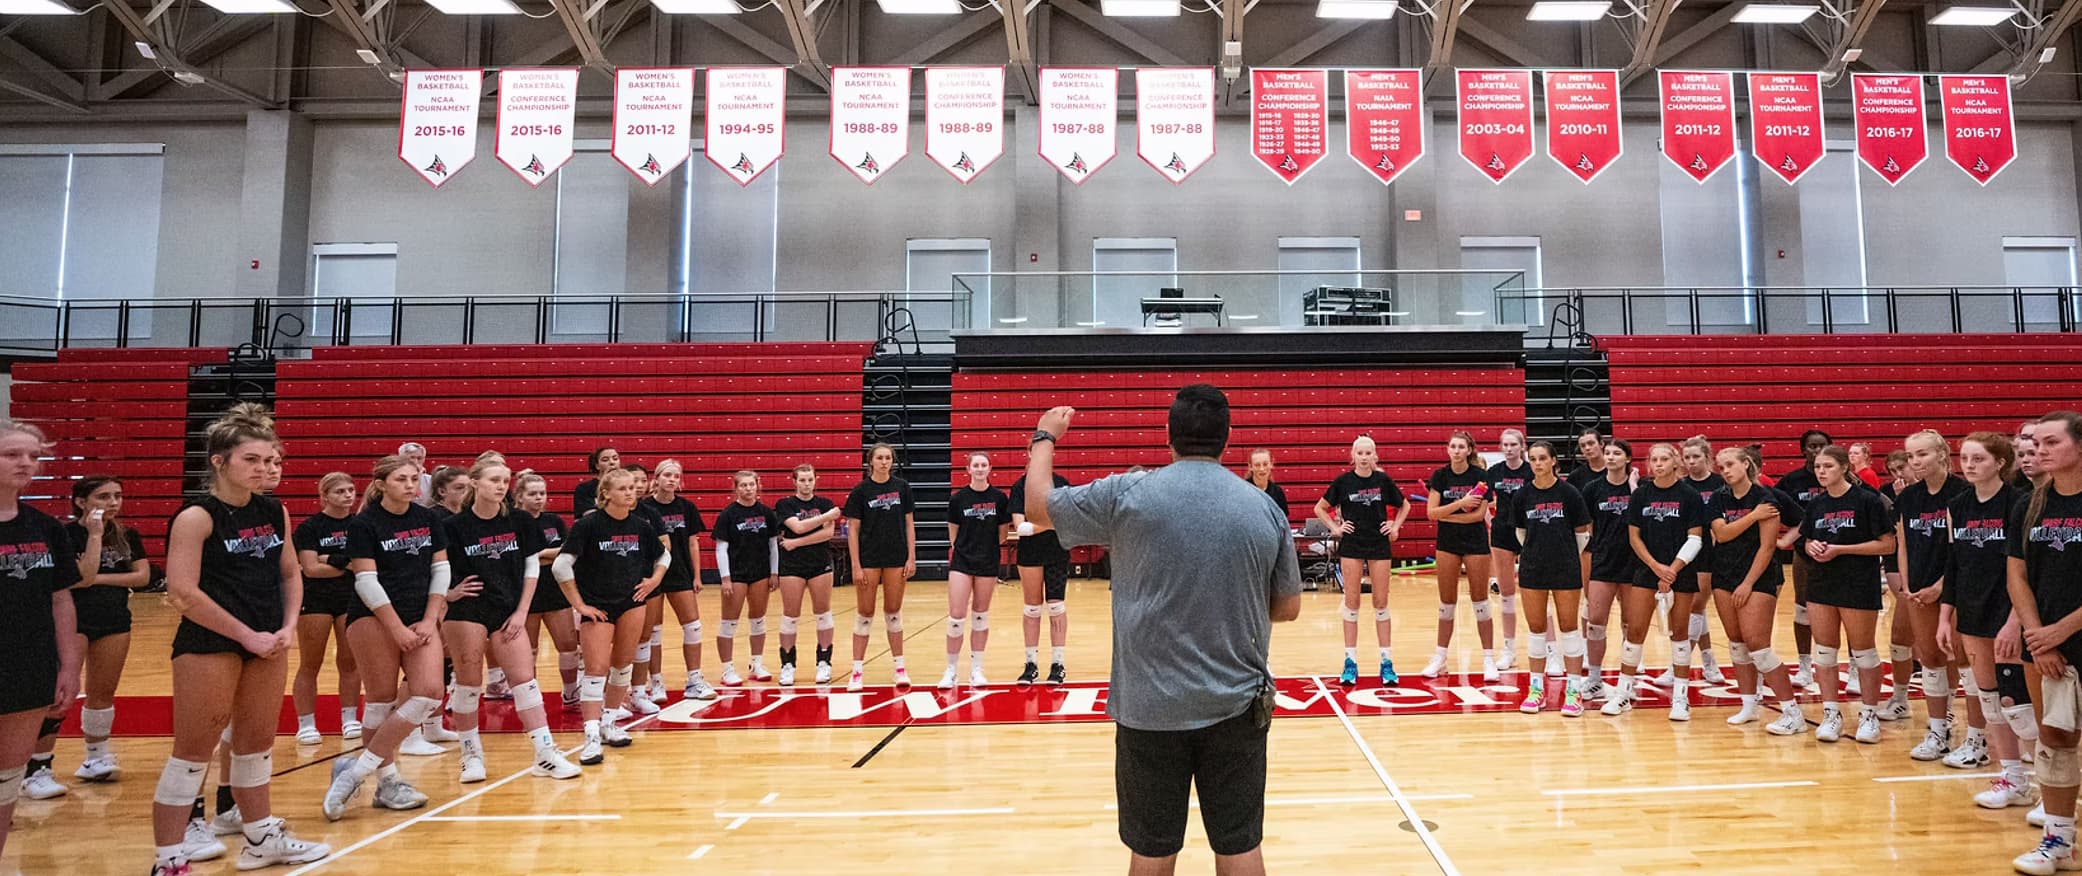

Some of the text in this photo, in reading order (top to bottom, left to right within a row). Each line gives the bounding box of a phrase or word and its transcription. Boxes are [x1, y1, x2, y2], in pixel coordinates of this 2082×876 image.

[1276, 73, 1301, 81] MEN'S
[1671, 83, 1720, 91] BASKETBALL
[1760, 84, 1809, 92] BASKETBALL
[1864, 86, 1912, 94] BASKETBALL
[1467, 94, 1521, 102] CONFERENCE
[1670, 95, 1722, 103] CONFERENCE
[1863, 98, 1913, 106] CONFERENCE
[1555, 103, 1610, 111] TOURNAMENT
[414, 126, 465, 136] 2015-16
[511, 125, 562, 136] 2015-16
[627, 124, 675, 135] 2011-12
[719, 124, 774, 134] 1994-95
[844, 123, 898, 133] 1988-89
[939, 122, 993, 133] 1988-89
[1052, 123, 1105, 134] 1987-88
[1151, 124, 1203, 134] 1987-88
[1466, 124, 1525, 134] 2003-04
[1560, 124, 1607, 135] 2010-11
[1675, 124, 1721, 135] 2011-12
[1765, 125, 1810, 136] 2011-12
[1867, 127, 1913, 138] 2016-17
[1956, 128, 2001, 138] 2016-17
[658, 690, 1010, 722] UW
